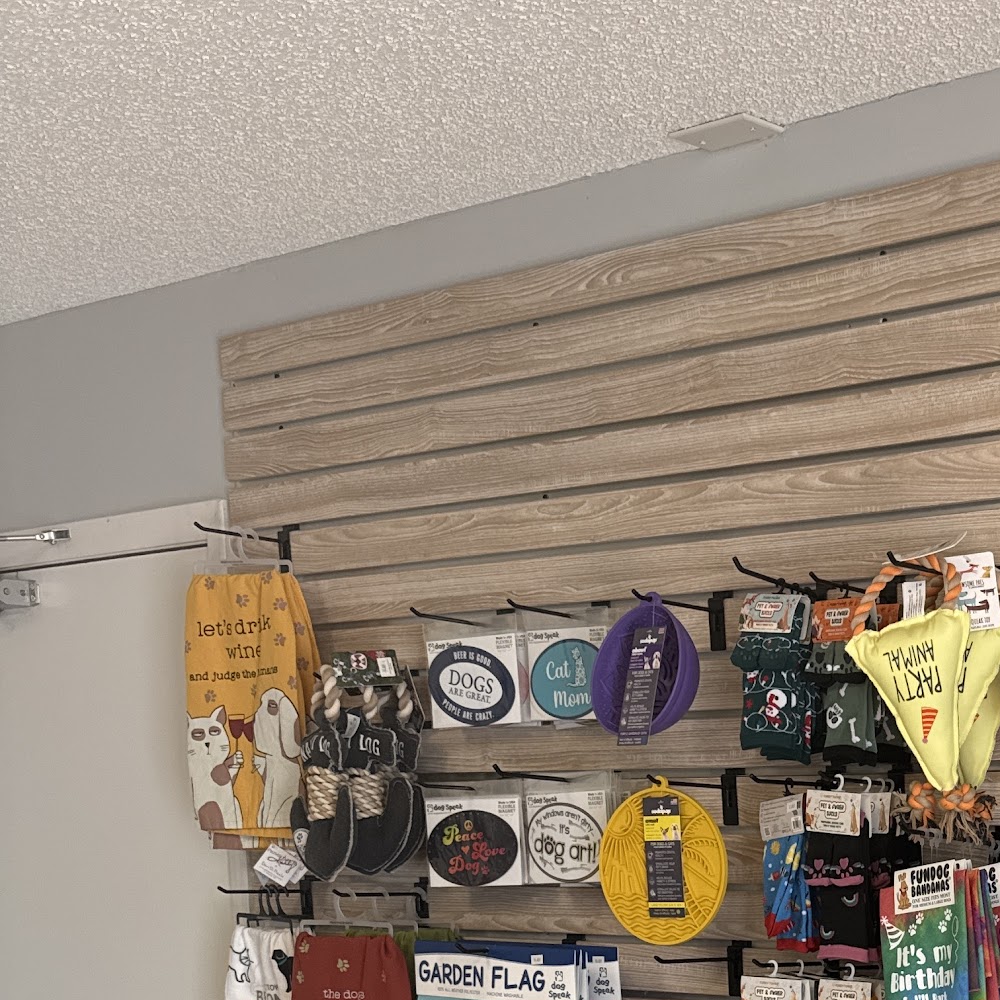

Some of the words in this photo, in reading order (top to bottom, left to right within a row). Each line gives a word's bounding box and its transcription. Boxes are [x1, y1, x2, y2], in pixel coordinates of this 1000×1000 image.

[197, 619, 232, 637] let's
[453, 650, 467, 661] BEER
[469, 651, 475, 661] IS
[883, 639, 934, 672] ANIMAL
[190, 671, 209, 682] and
[211, 671, 240, 682] judge
[242, 669, 256, 679] the
[546, 661, 570, 680] Cat
[448, 669, 494, 694] DOGS
[896, 665, 942, 703] PARTY
[448, 687, 464, 698] ARE
[553, 690, 591, 708] Mom
[442, 699, 461, 717] PEOPLE
[359, 734, 381, 757] LOG
[542, 809, 564, 820] windows
[442, 823, 484, 845] Peace
[559, 824, 570, 834] It's
[471, 843, 506, 859] Love
[534, 832, 565, 865] dog
[570, 842, 596, 863] art!
[448, 857, 480, 875] Dog
[911, 863, 950, 885] FUNDOG
[896, 946, 925, 968] It's
[934, 944, 953, 963] my
[418, 960, 485, 988] GARDEN
[491, 966, 546, 992] FLAG
[890, 968, 955, 993] Birthday
[323, 989, 340, 999] the
[548, 989, 572, 1000] Speak
[551, 981, 566, 991] dog
